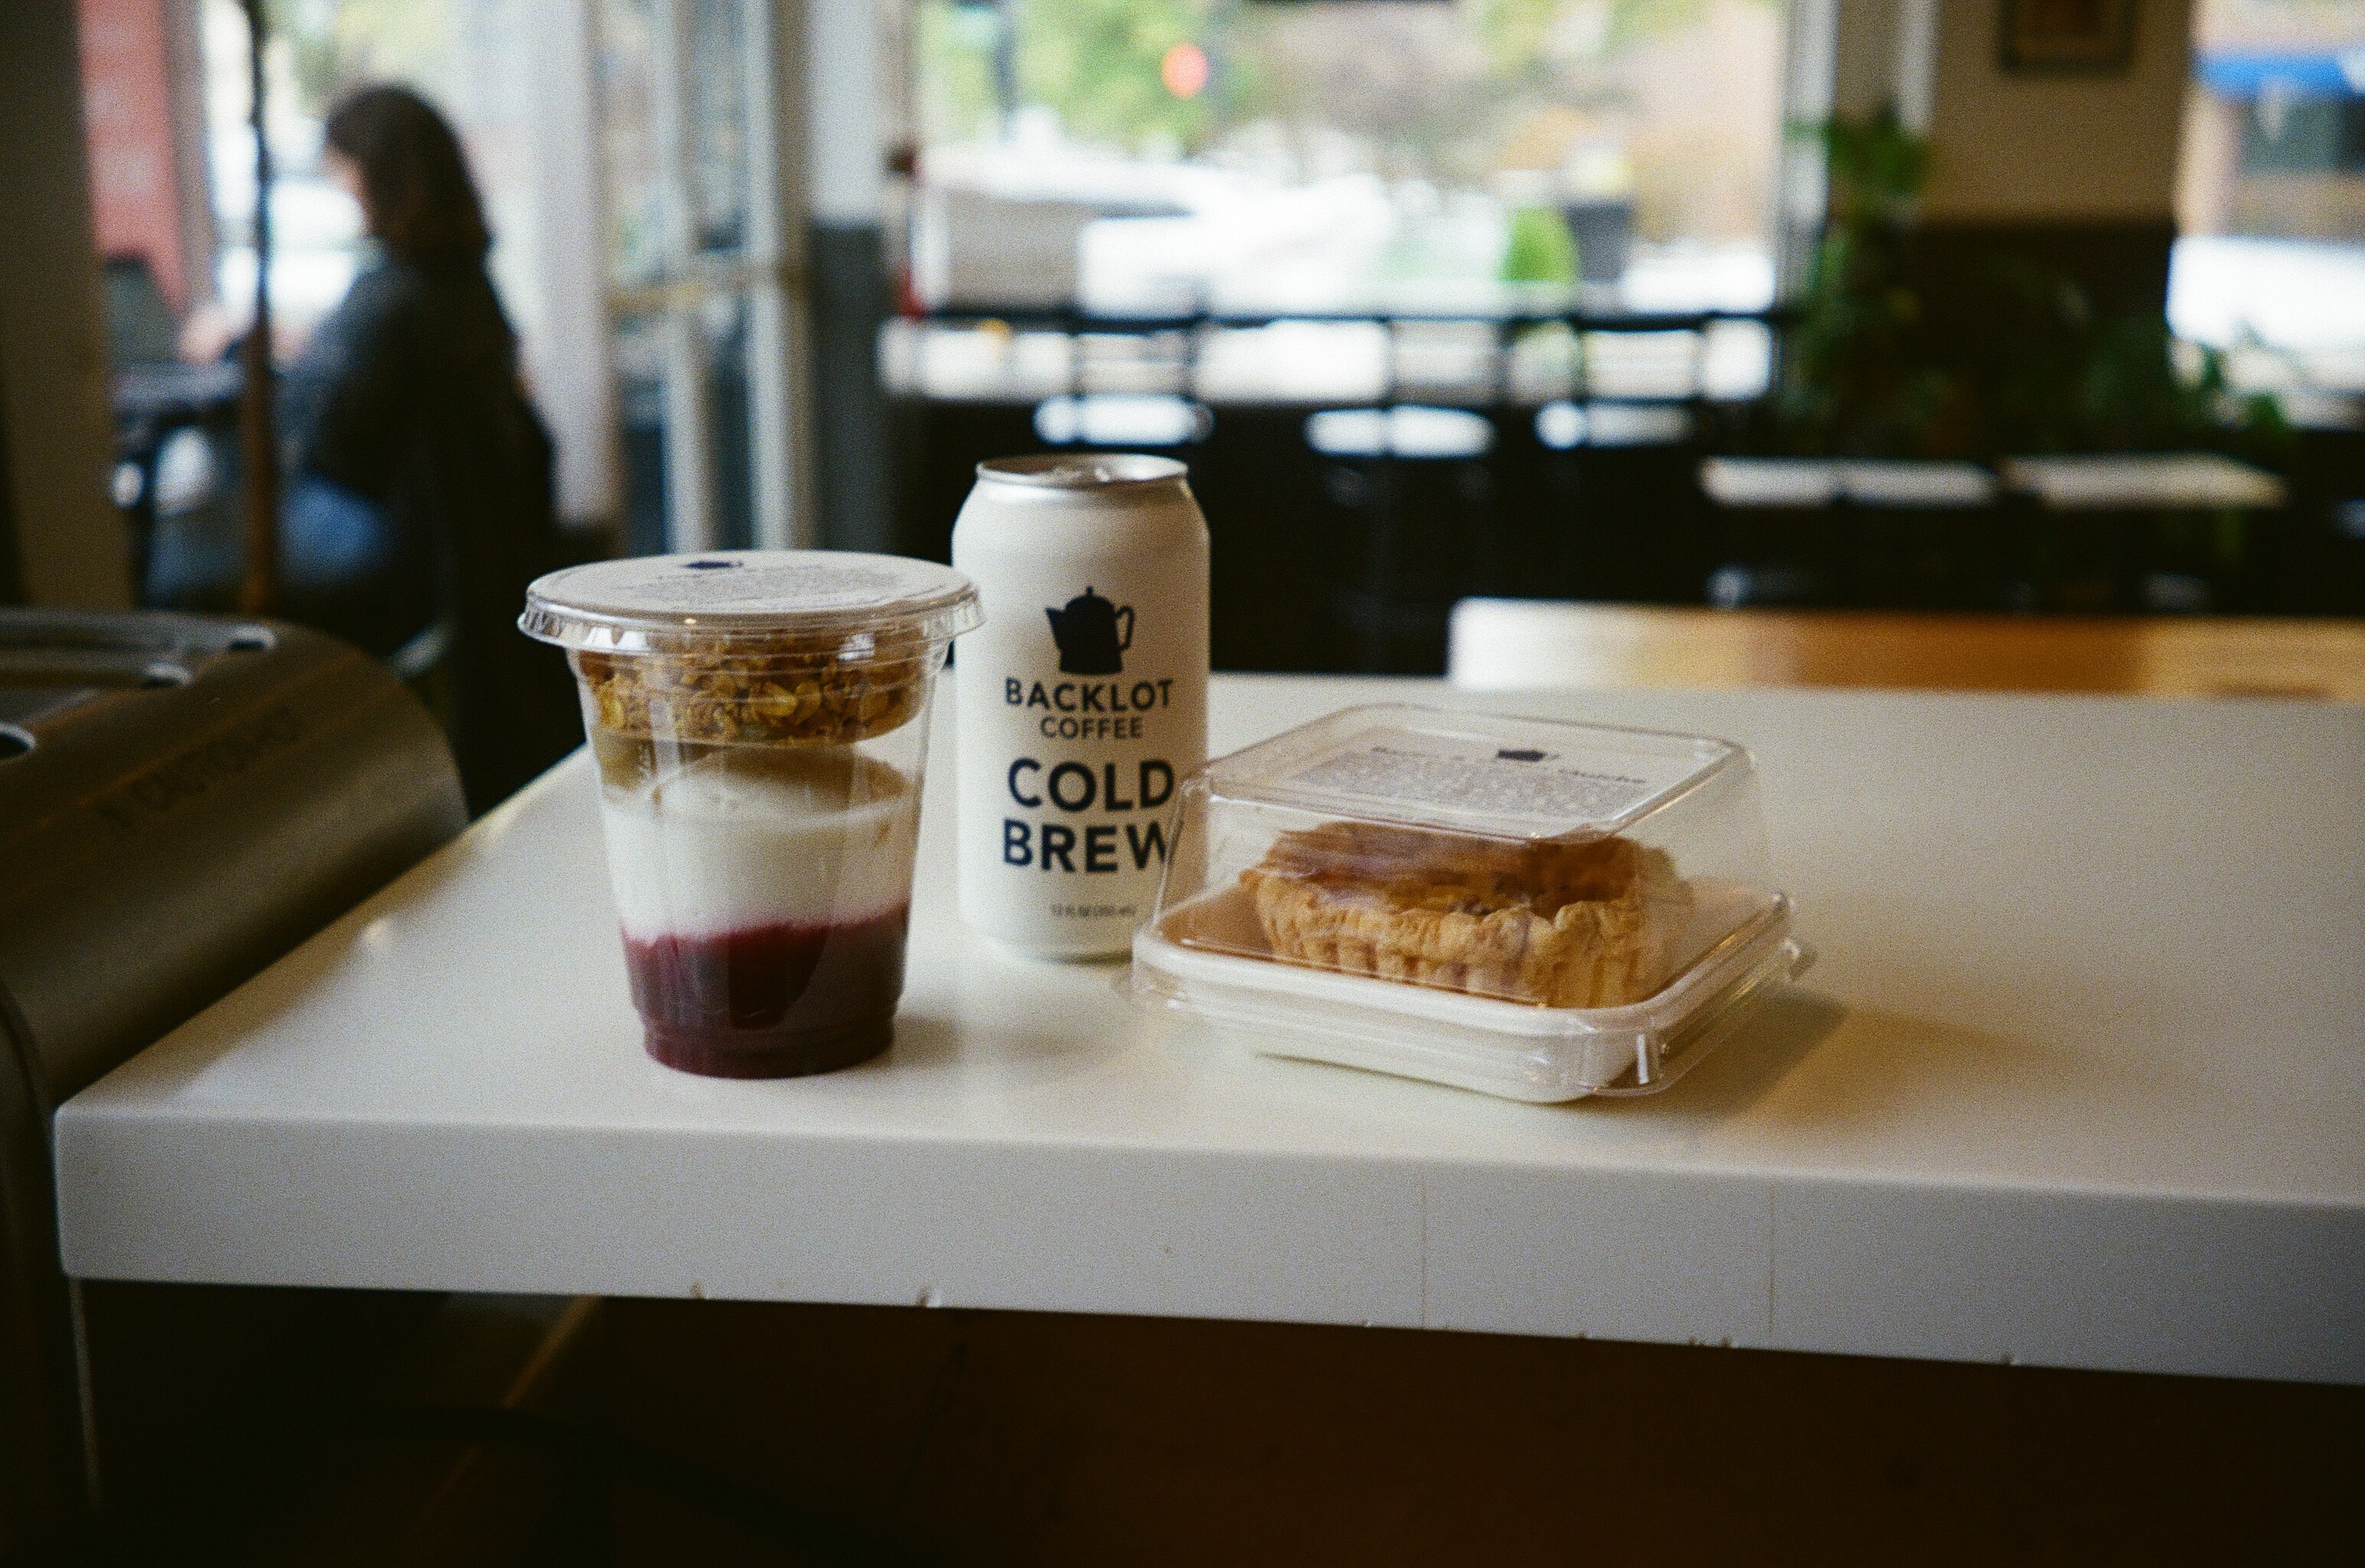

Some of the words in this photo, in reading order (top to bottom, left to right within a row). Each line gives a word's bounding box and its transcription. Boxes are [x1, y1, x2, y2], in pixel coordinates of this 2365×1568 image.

[1005, 677, 1174, 714] BACKLOT
[1040, 716, 1143, 740] COFFEE
[1008, 756, 1176, 815] COLD
[1004, 818, 1168, 874] BREW
